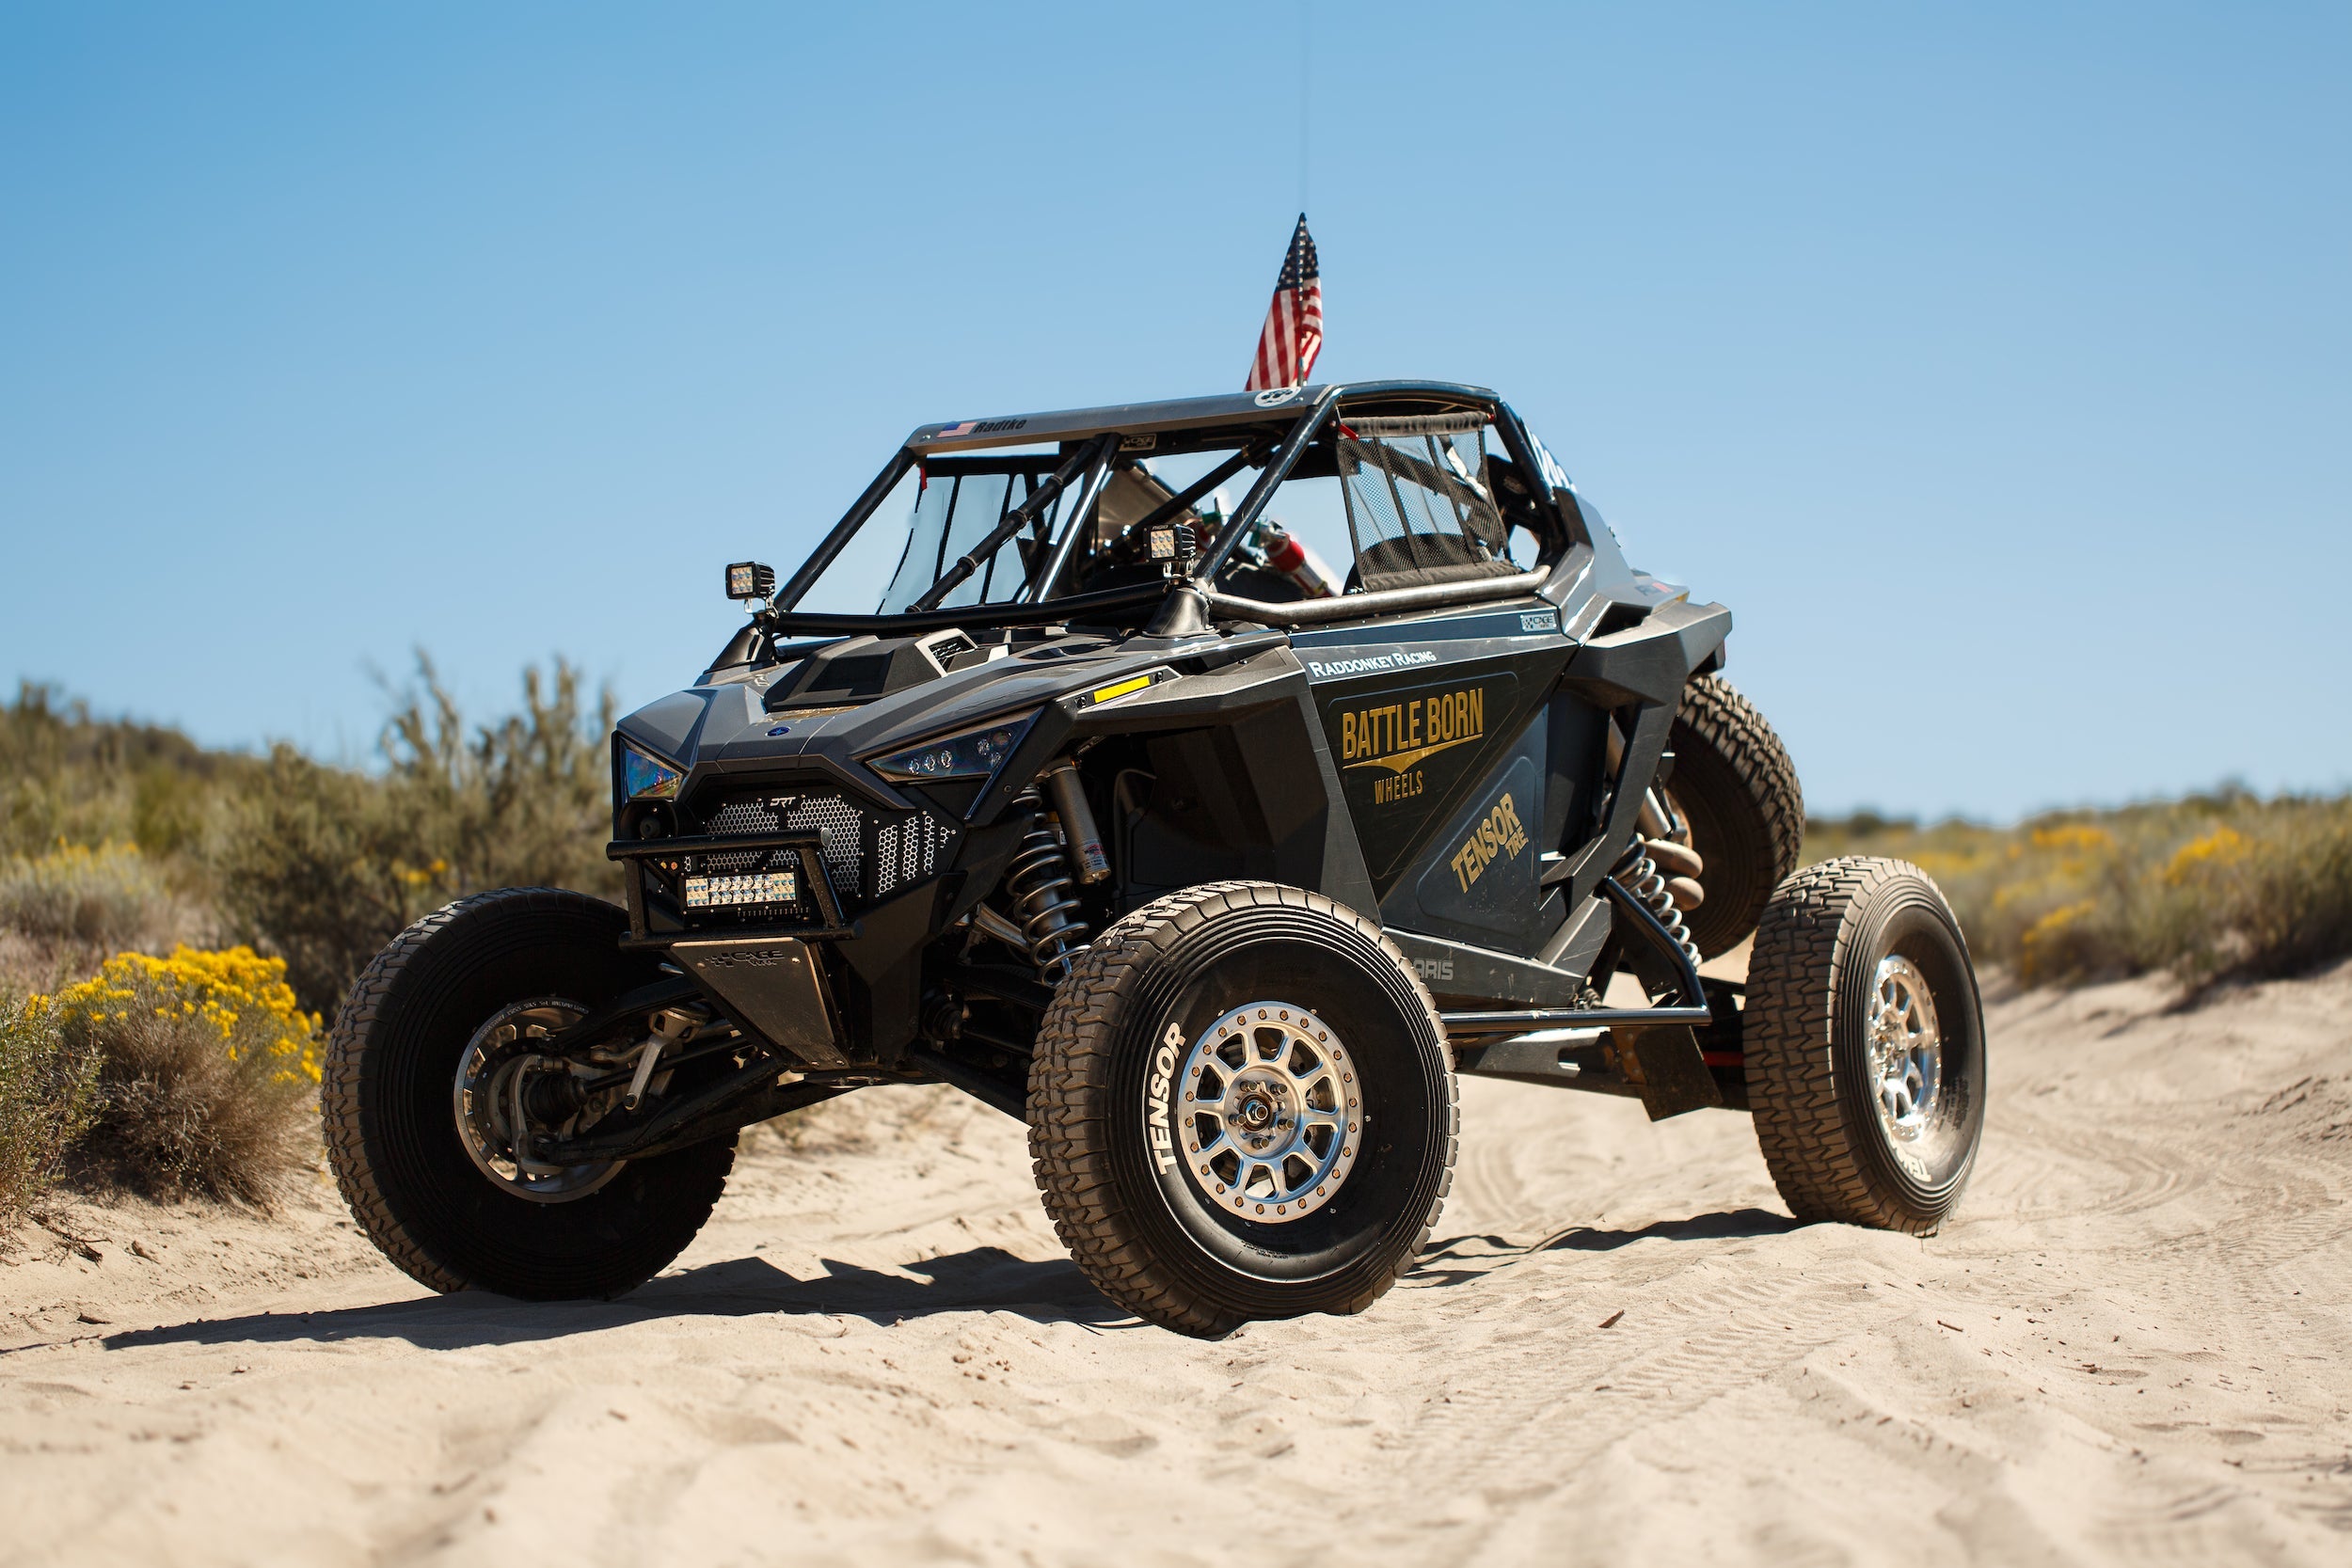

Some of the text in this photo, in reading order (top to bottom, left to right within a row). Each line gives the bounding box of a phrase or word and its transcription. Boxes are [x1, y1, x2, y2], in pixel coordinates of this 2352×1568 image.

[974, 419, 1027, 434] Radtke
[1343, 687, 1484, 760] BATTLE BORN
[1374, 769, 1423, 805] WHEELS
[1450, 792, 1521, 895] TENSOR
[1148, 1022, 1187, 1176] TENSOR
